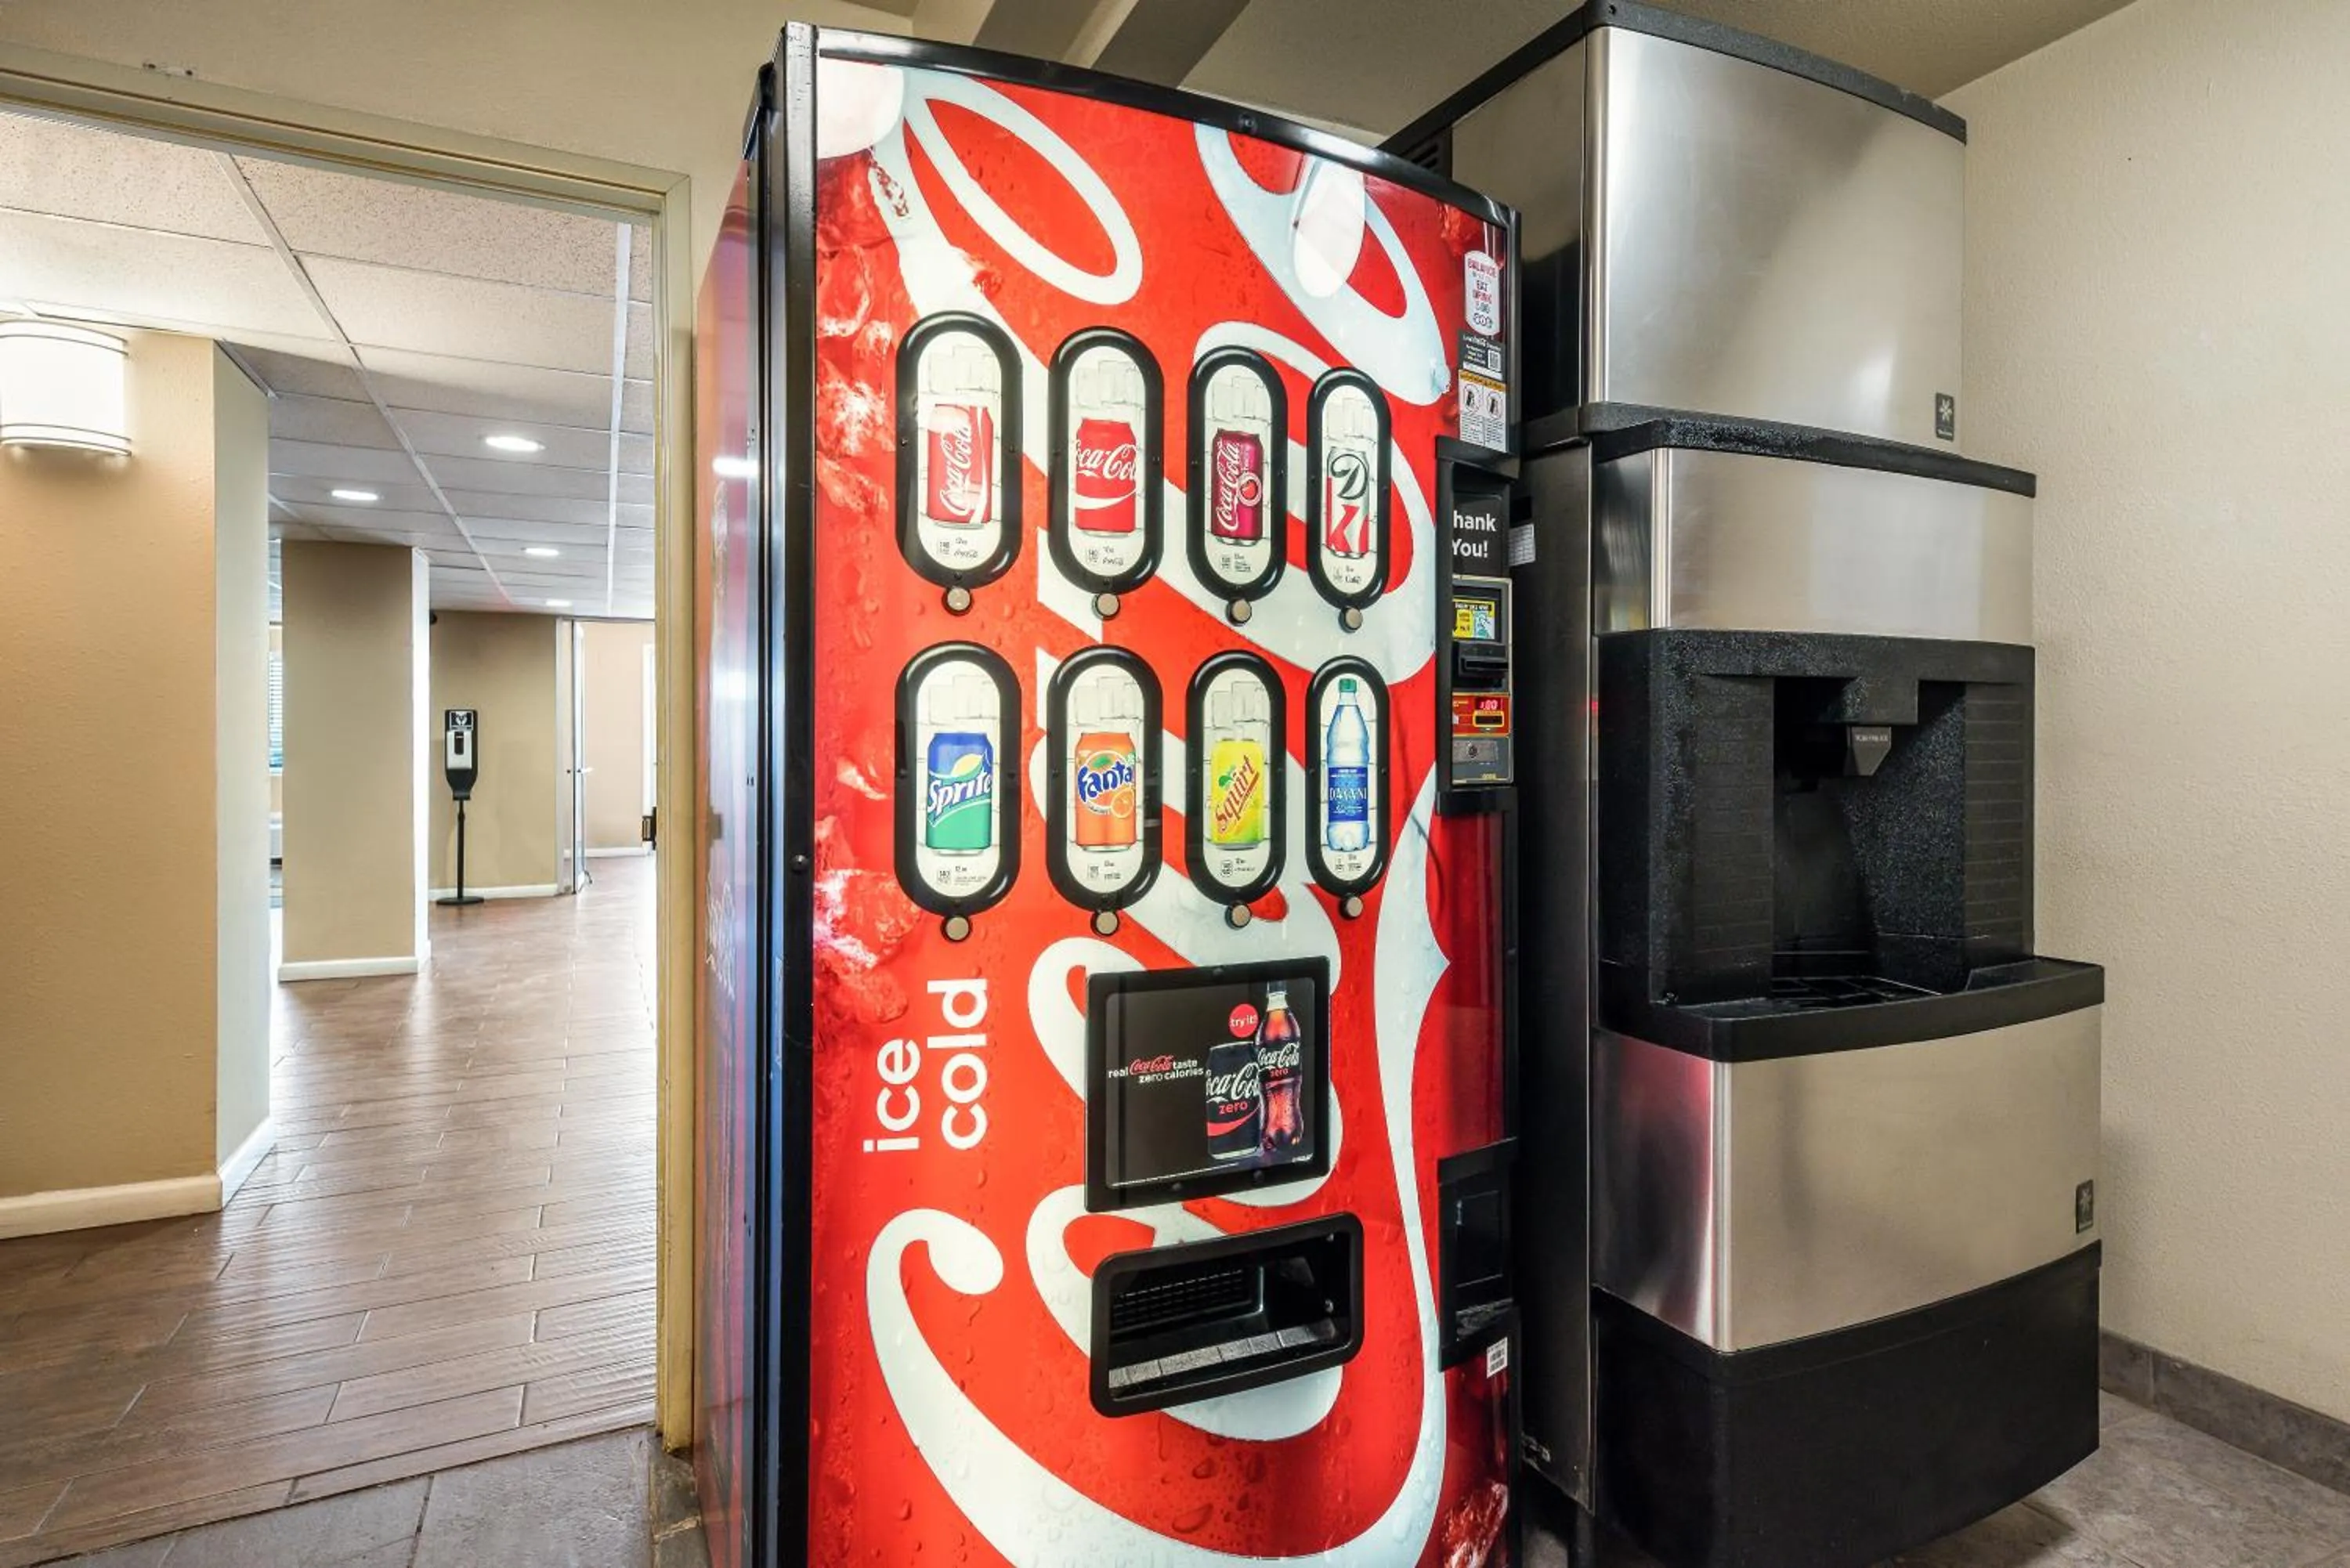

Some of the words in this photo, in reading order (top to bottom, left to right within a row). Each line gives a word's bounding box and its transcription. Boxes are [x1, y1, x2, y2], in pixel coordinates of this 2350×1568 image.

[1453, 510, 1496, 532] hank
[1452, 538, 1488, 558] You!
[928, 771, 992, 815] Sprite
[1230, 1017, 1246, 1028] try
[927, 977, 988, 1150] cold
[1108, 1067, 1128, 1078] real
[1173, 1059, 1198, 1069] taste
[1269, 1068, 1289, 1078] zero
[1138, 1072, 1163, 1083] zero
[1164, 1068, 1204, 1080] calories
[863, 1039, 920, 1153] ice
[1219, 1101, 1248, 1115] zero
